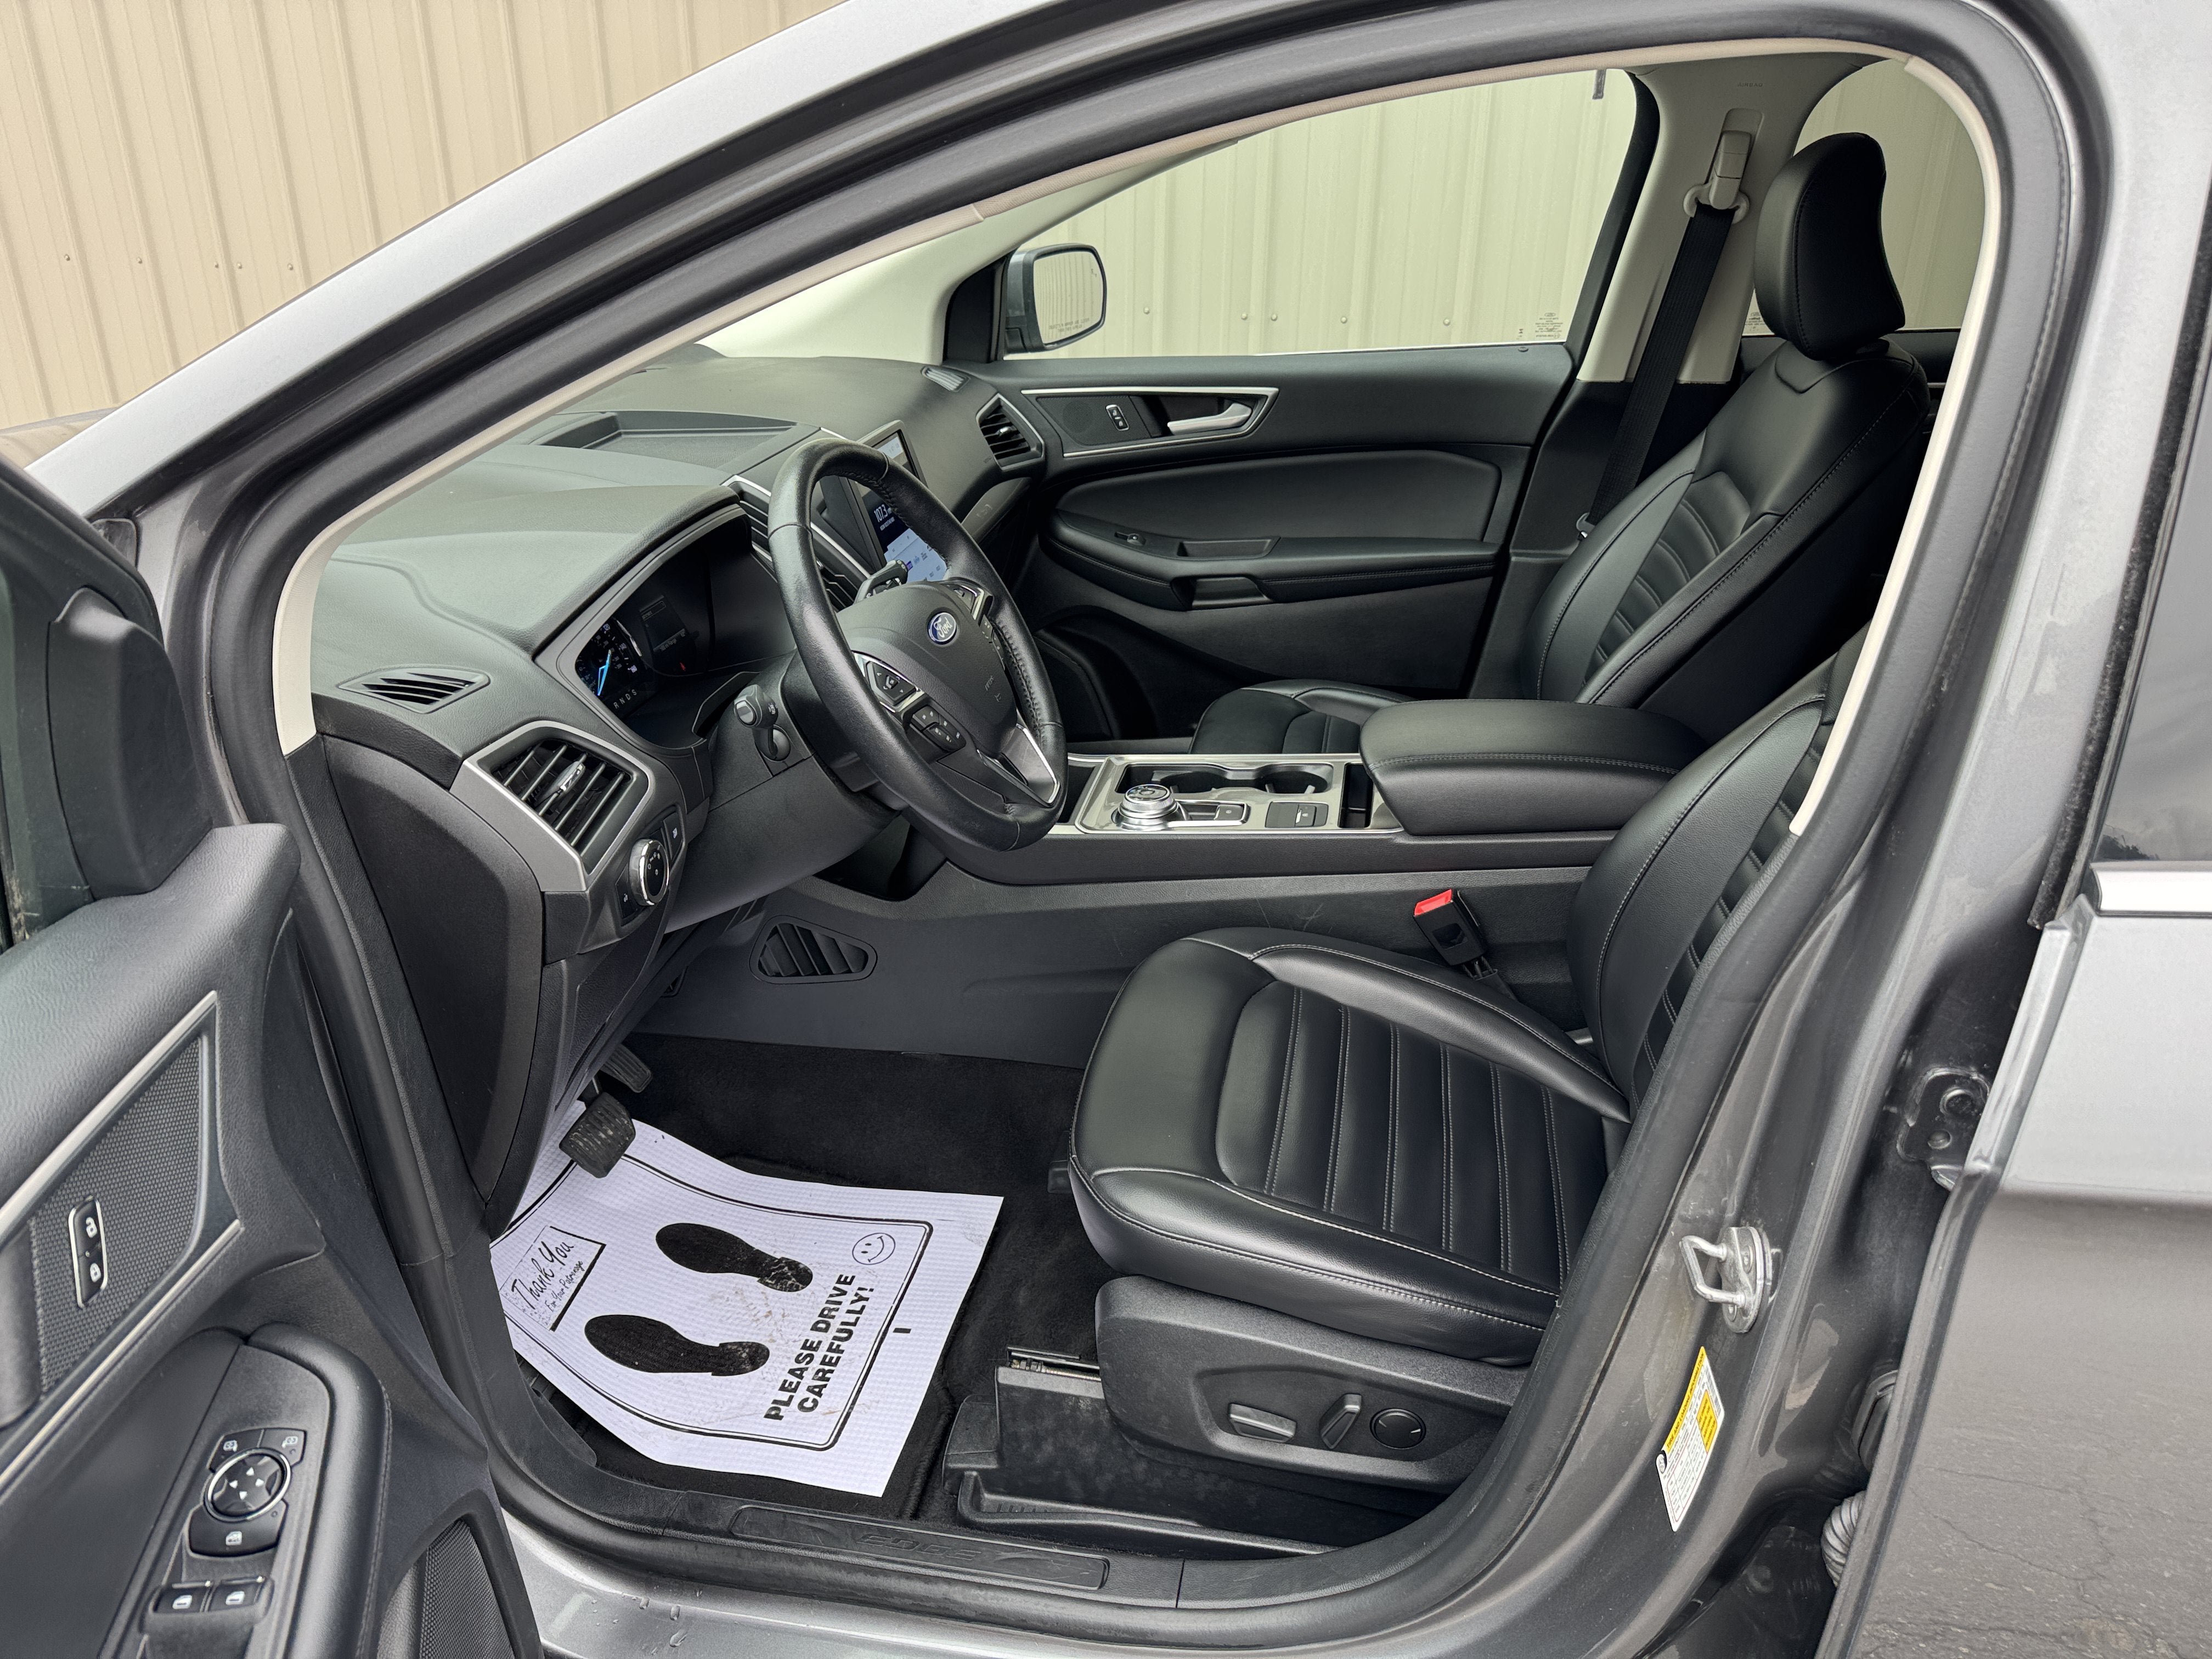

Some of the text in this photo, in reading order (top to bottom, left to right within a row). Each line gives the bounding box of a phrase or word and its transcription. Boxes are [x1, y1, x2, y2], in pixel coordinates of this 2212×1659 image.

[933, 617, 953, 638] Ford
[511, 1241, 574, 1310] Thank You
[545, 1261, 585, 1312] For Your Patronage
[763, 1274, 856, 1421] PLEASE DRIVE
[797, 1286, 874, 1413] CAREFULLY!
[855, 1534, 983, 1561] EDGE
